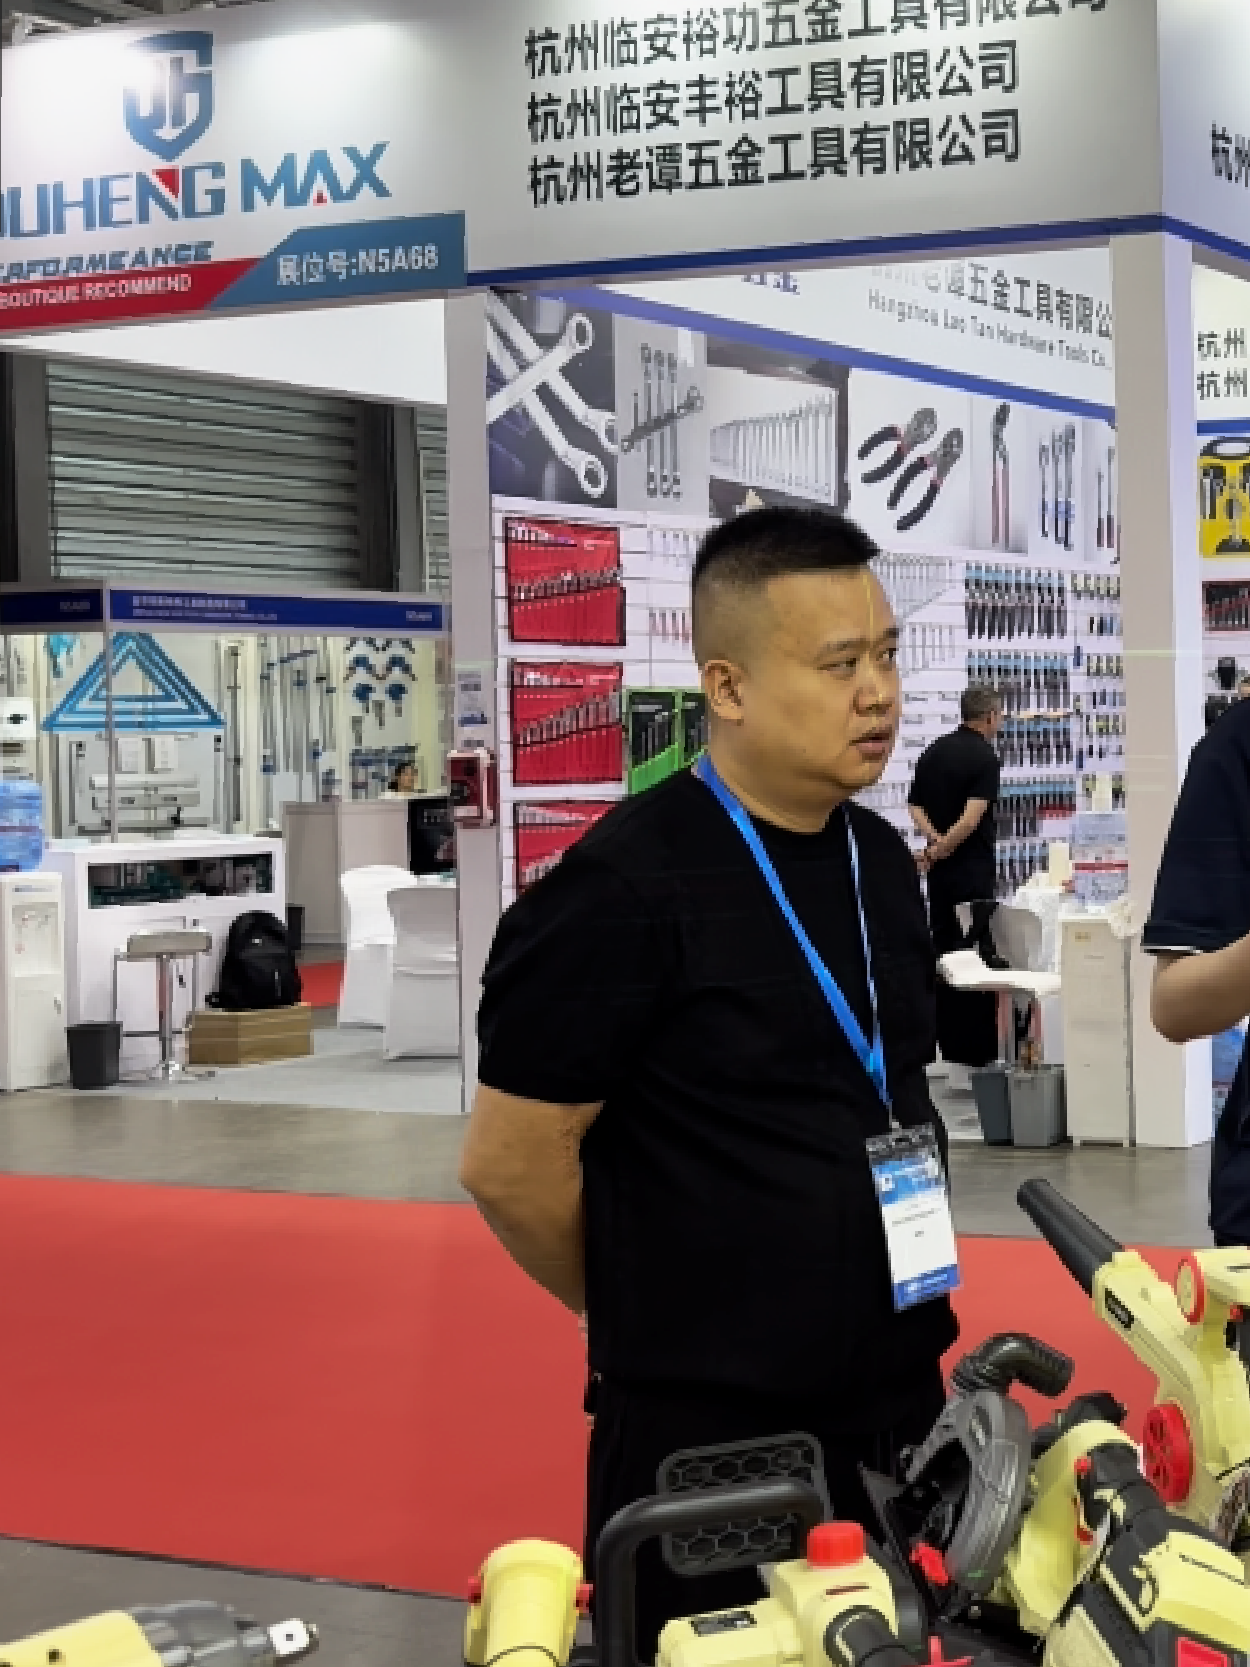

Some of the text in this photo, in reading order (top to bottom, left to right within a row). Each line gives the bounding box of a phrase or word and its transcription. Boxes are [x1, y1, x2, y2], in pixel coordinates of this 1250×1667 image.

[525, 0, 1106, 80] 杭州临安裕功五金工具有限
[527, 39, 1020, 144] 杭州临安丰裕工具有限公司
[241, 141, 392, 213] MAX
[529, 108, 1021, 208] 杭州老谭五金工具有限公司
[84, 273, 192, 301] RECOMMEND
[277, 244, 439, 286] 展位号:N5A68
[872, 260, 1112, 341] 老谭五金工具有限公
